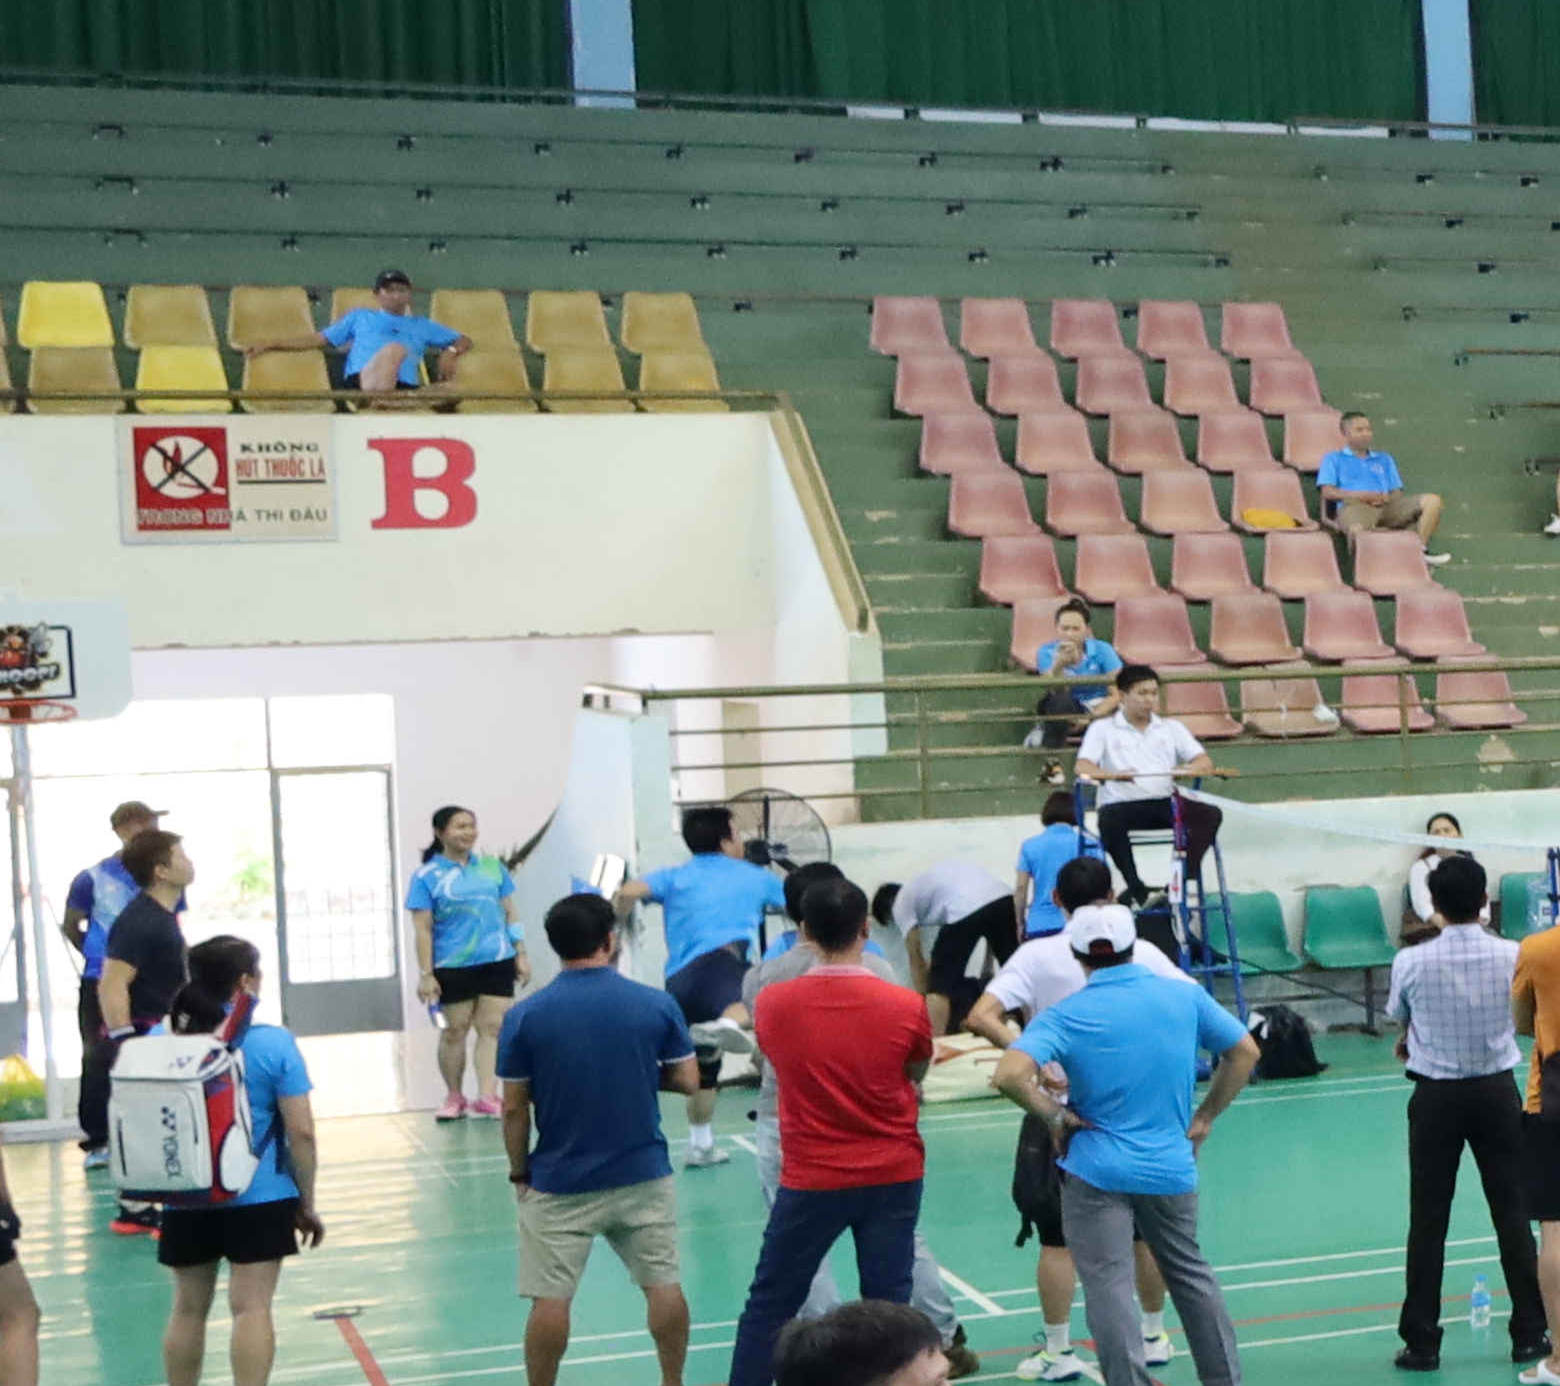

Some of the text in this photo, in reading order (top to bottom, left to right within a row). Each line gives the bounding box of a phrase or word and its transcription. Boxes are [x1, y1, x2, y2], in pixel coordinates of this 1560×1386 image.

[239, 440, 319, 454] KHÔNG
[366, 437, 478, 530] B
[254, 509, 284, 522] THI
